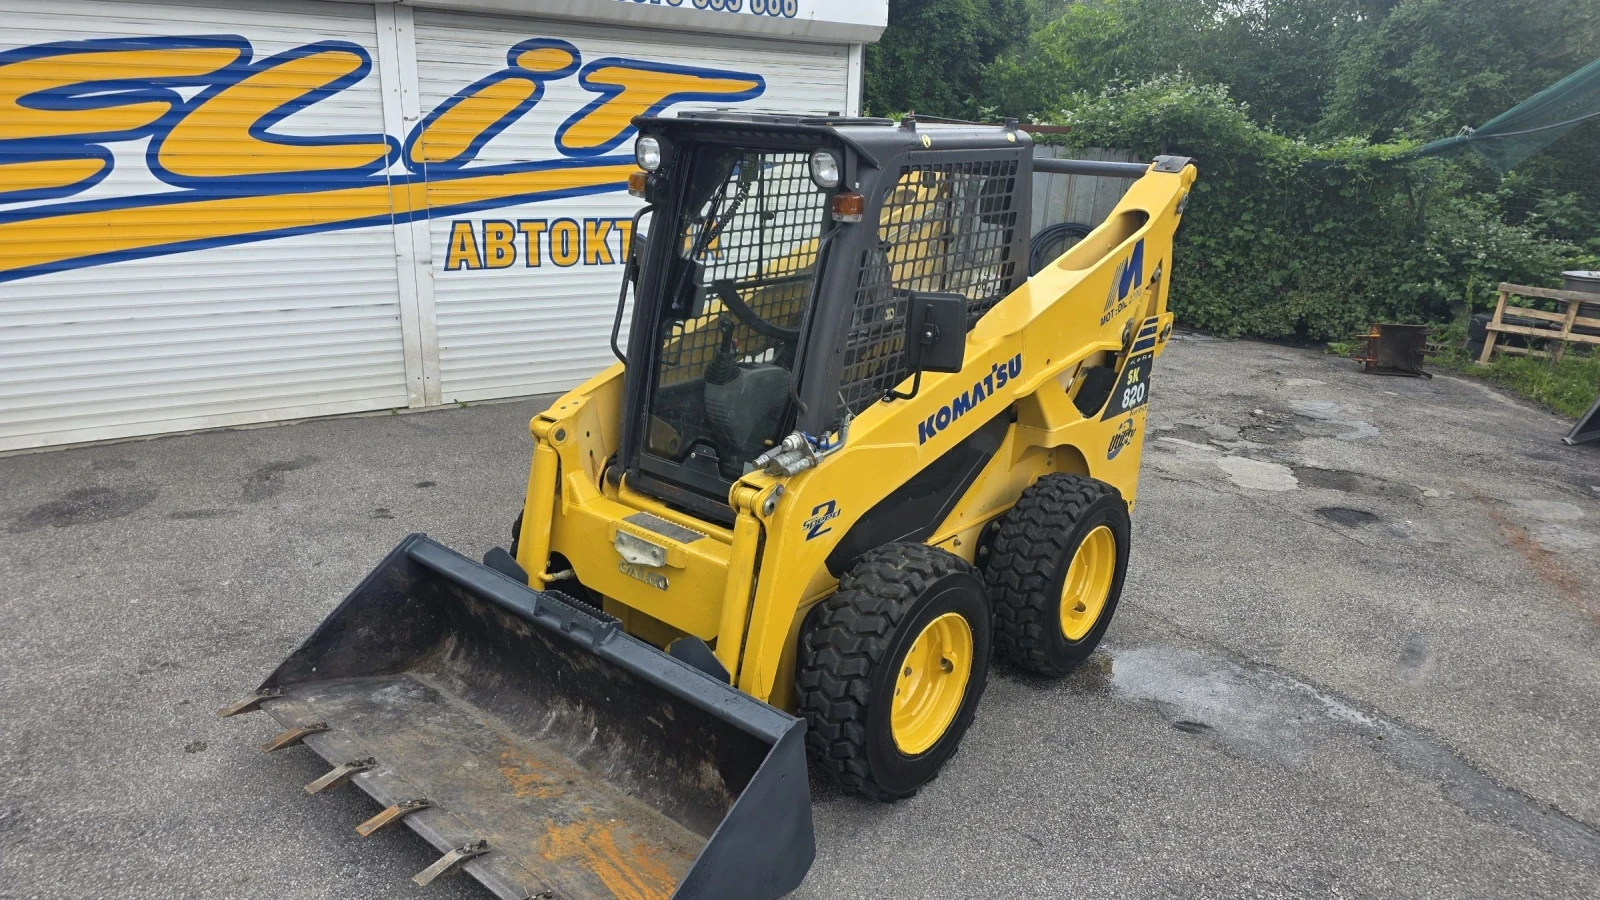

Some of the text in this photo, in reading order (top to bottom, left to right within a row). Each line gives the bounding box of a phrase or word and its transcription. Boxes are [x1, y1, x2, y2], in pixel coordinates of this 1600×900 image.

[1127, 367, 1140, 386] SK
[918, 353, 1022, 446] KOMATSU
[1122, 382, 1145, 409] 820
[806, 499, 836, 541] 2
